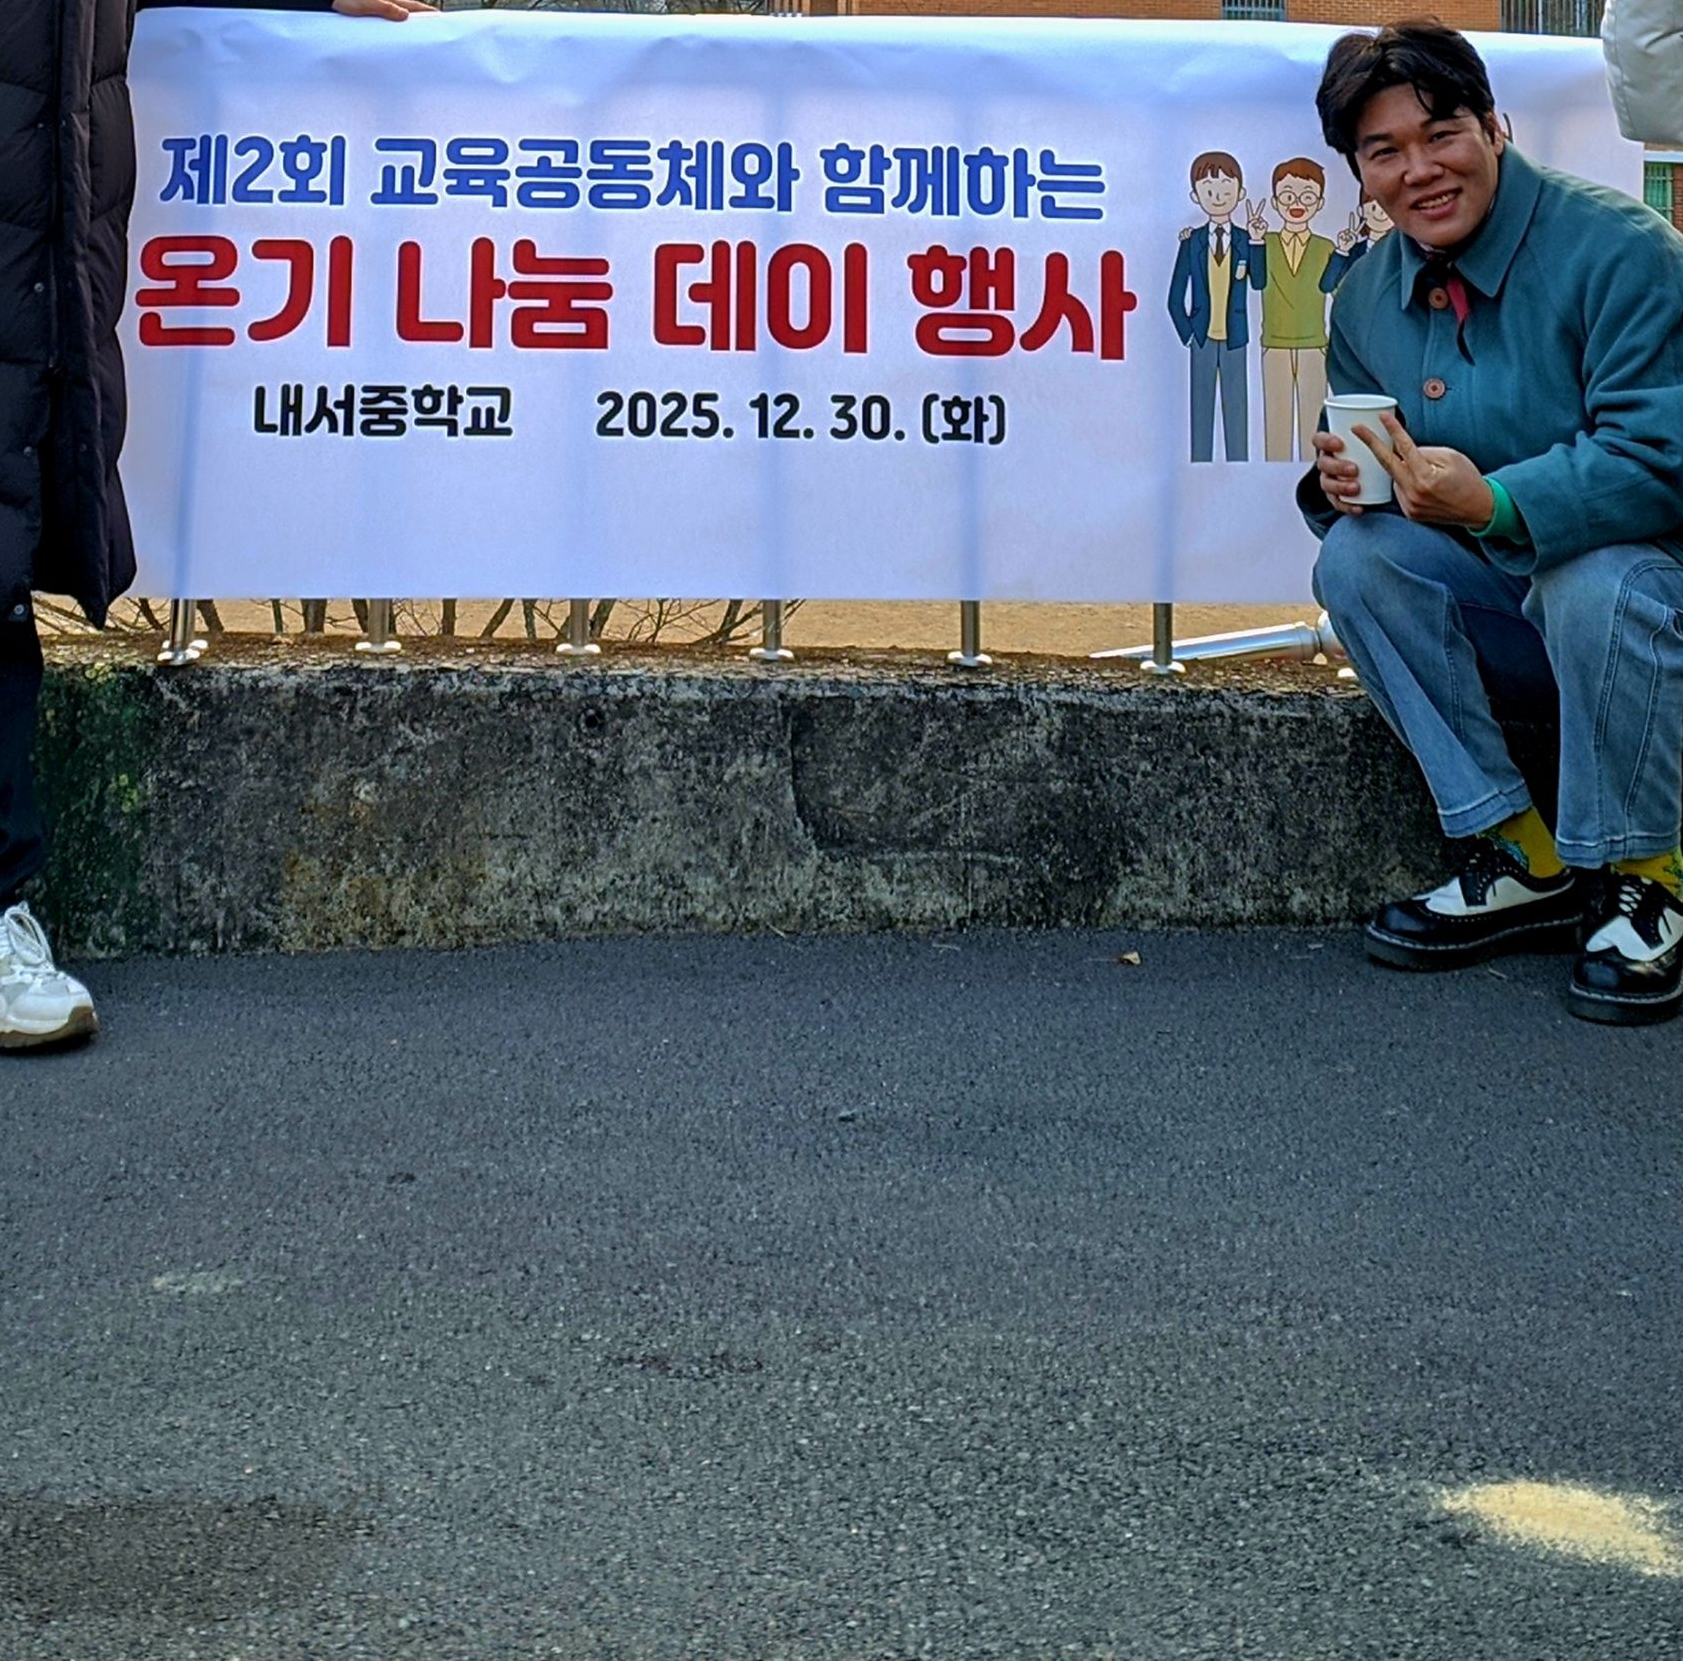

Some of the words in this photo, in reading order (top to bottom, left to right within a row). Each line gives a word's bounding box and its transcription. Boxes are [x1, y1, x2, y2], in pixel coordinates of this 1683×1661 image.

[158, 133, 346, 206] 제2회
[369, 137, 801, 213] 교육공동체와
[819, 143, 1107, 220] 함께하는
[135, 235, 354, 348] 온기
[397, 237, 614, 349] 나눔
[654, 241, 869, 355] 데이
[908, 246, 1138, 361] 행사
[253, 384, 513, 437] 내서중학교
[595, 391, 734, 438] 2025.
[749, 392, 814, 439] 12.
[829, 394, 905, 441] 30.
[921, 393, 1006, 445] (화)
